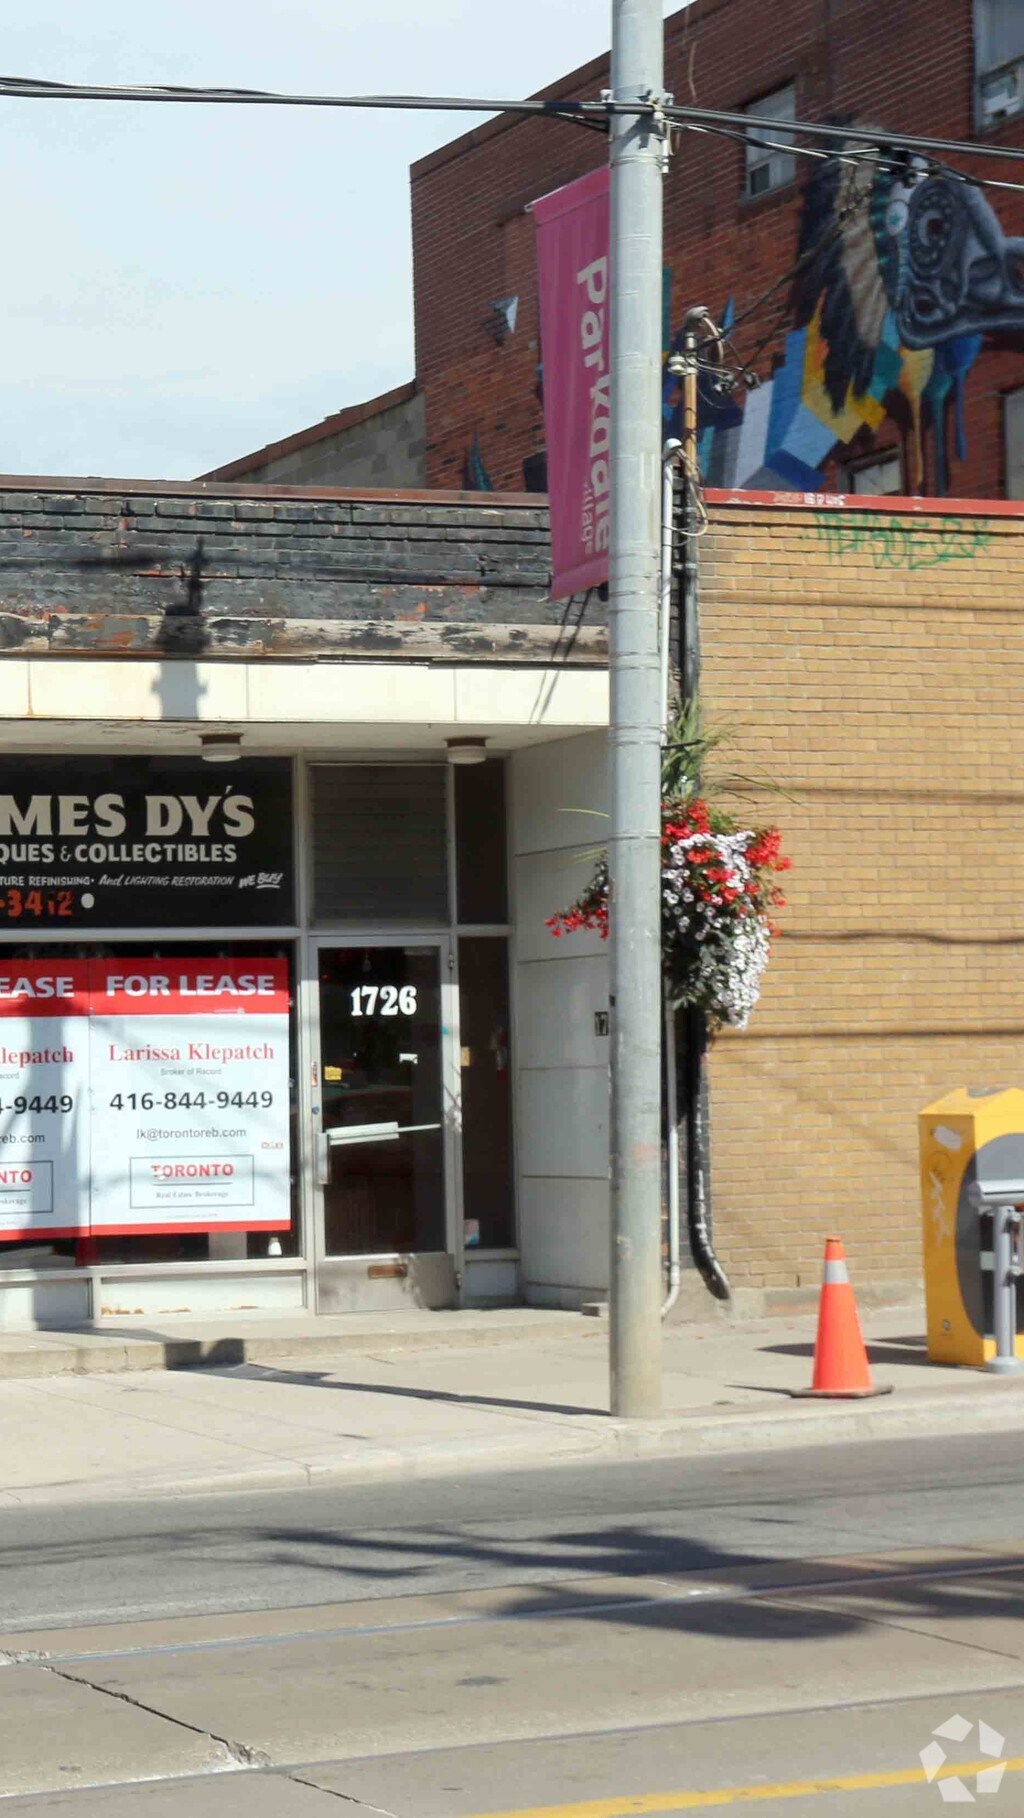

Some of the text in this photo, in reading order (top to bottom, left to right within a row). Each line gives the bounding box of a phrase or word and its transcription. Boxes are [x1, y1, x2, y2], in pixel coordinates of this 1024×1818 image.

[144, 785, 256, 838] DY'S
[60, 845, 72, 863] &
[75, 843, 237, 863] COLLECTIBLES
[123, 875, 167, 886] LIGHTING
[170, 875, 236, 886] RESTORATION
[106, 974, 276, 996] FOR LEASE
[350, 985, 417, 1016] 1726
[108, 1042, 275, 1064] Larissa Klepatch
[109, 1090, 274, 1111] 416-844-9449
[136, 1127, 247, 1141] lk@torontoreb.com
[150, 1163, 235, 1178] TORONTO
